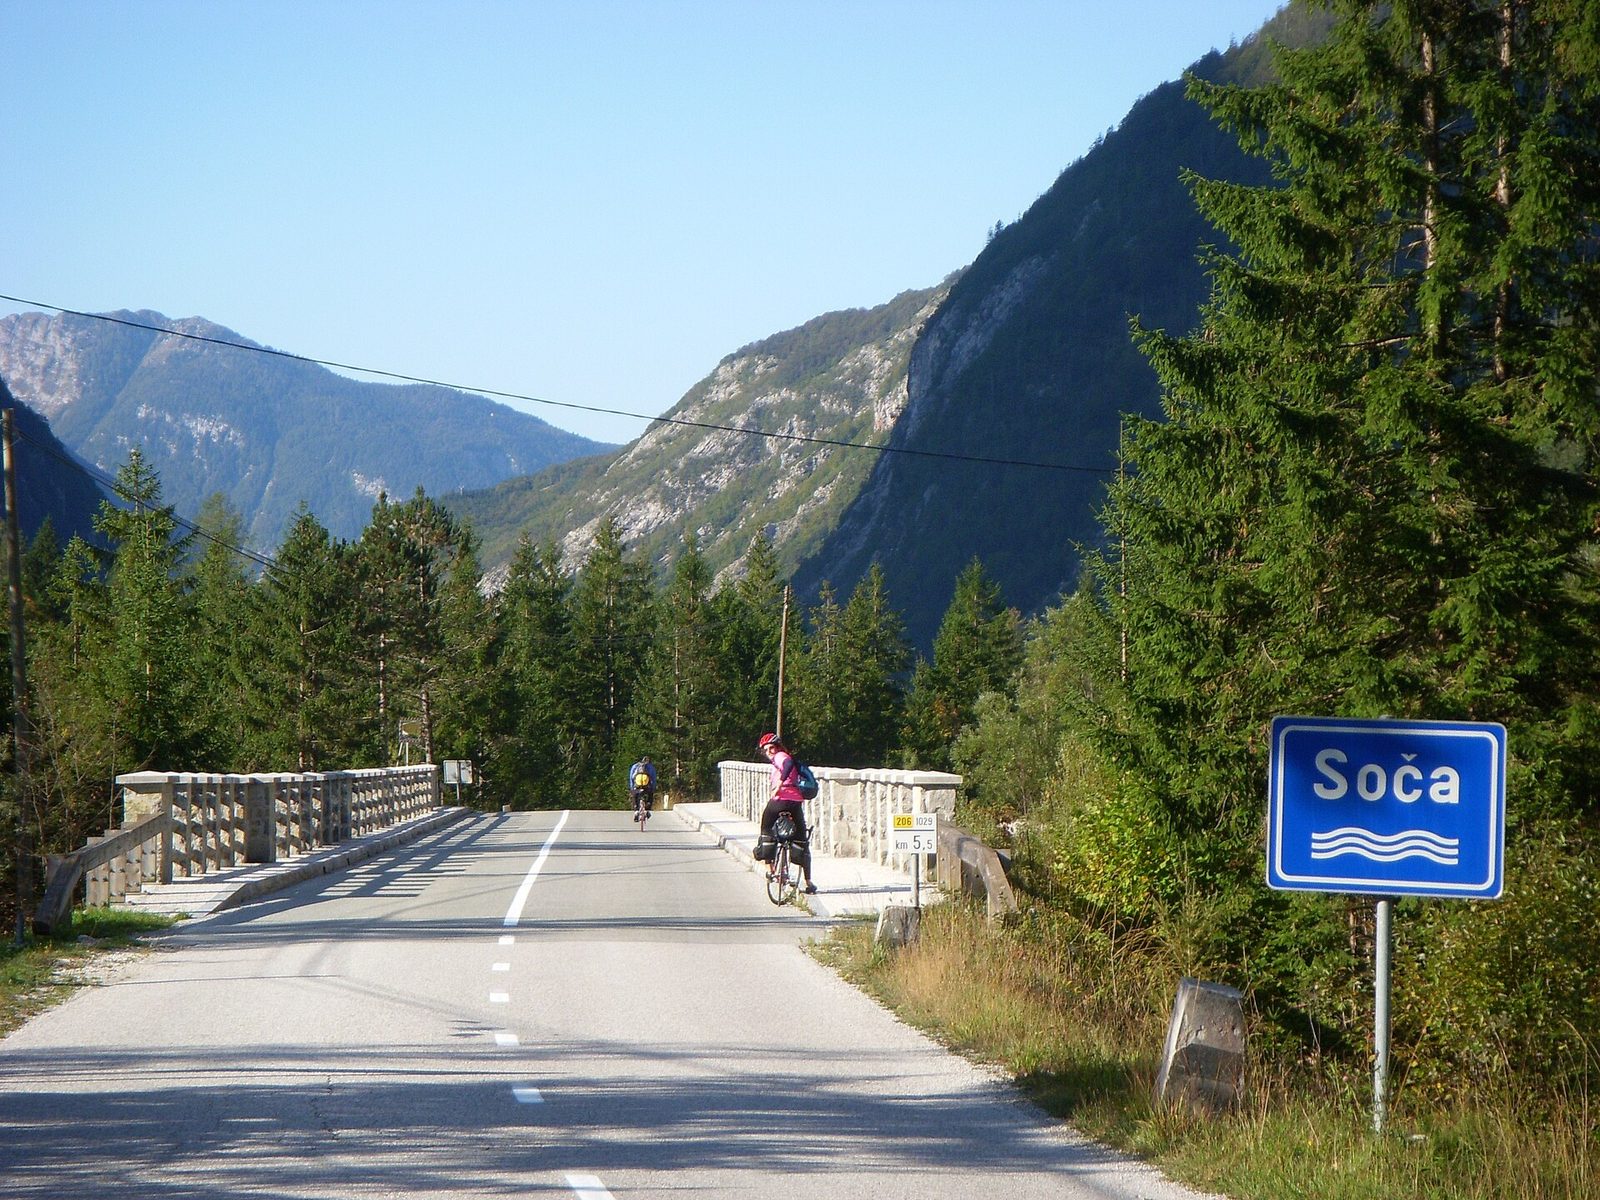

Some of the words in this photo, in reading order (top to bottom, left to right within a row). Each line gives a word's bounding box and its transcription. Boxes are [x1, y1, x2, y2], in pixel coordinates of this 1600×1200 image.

[1313, 748, 1460, 804] Soča
[896, 817, 912, 826] 206
[916, 817, 933, 826] 1029
[895, 840, 908, 850] km
[913, 835, 933, 851] 5,5
